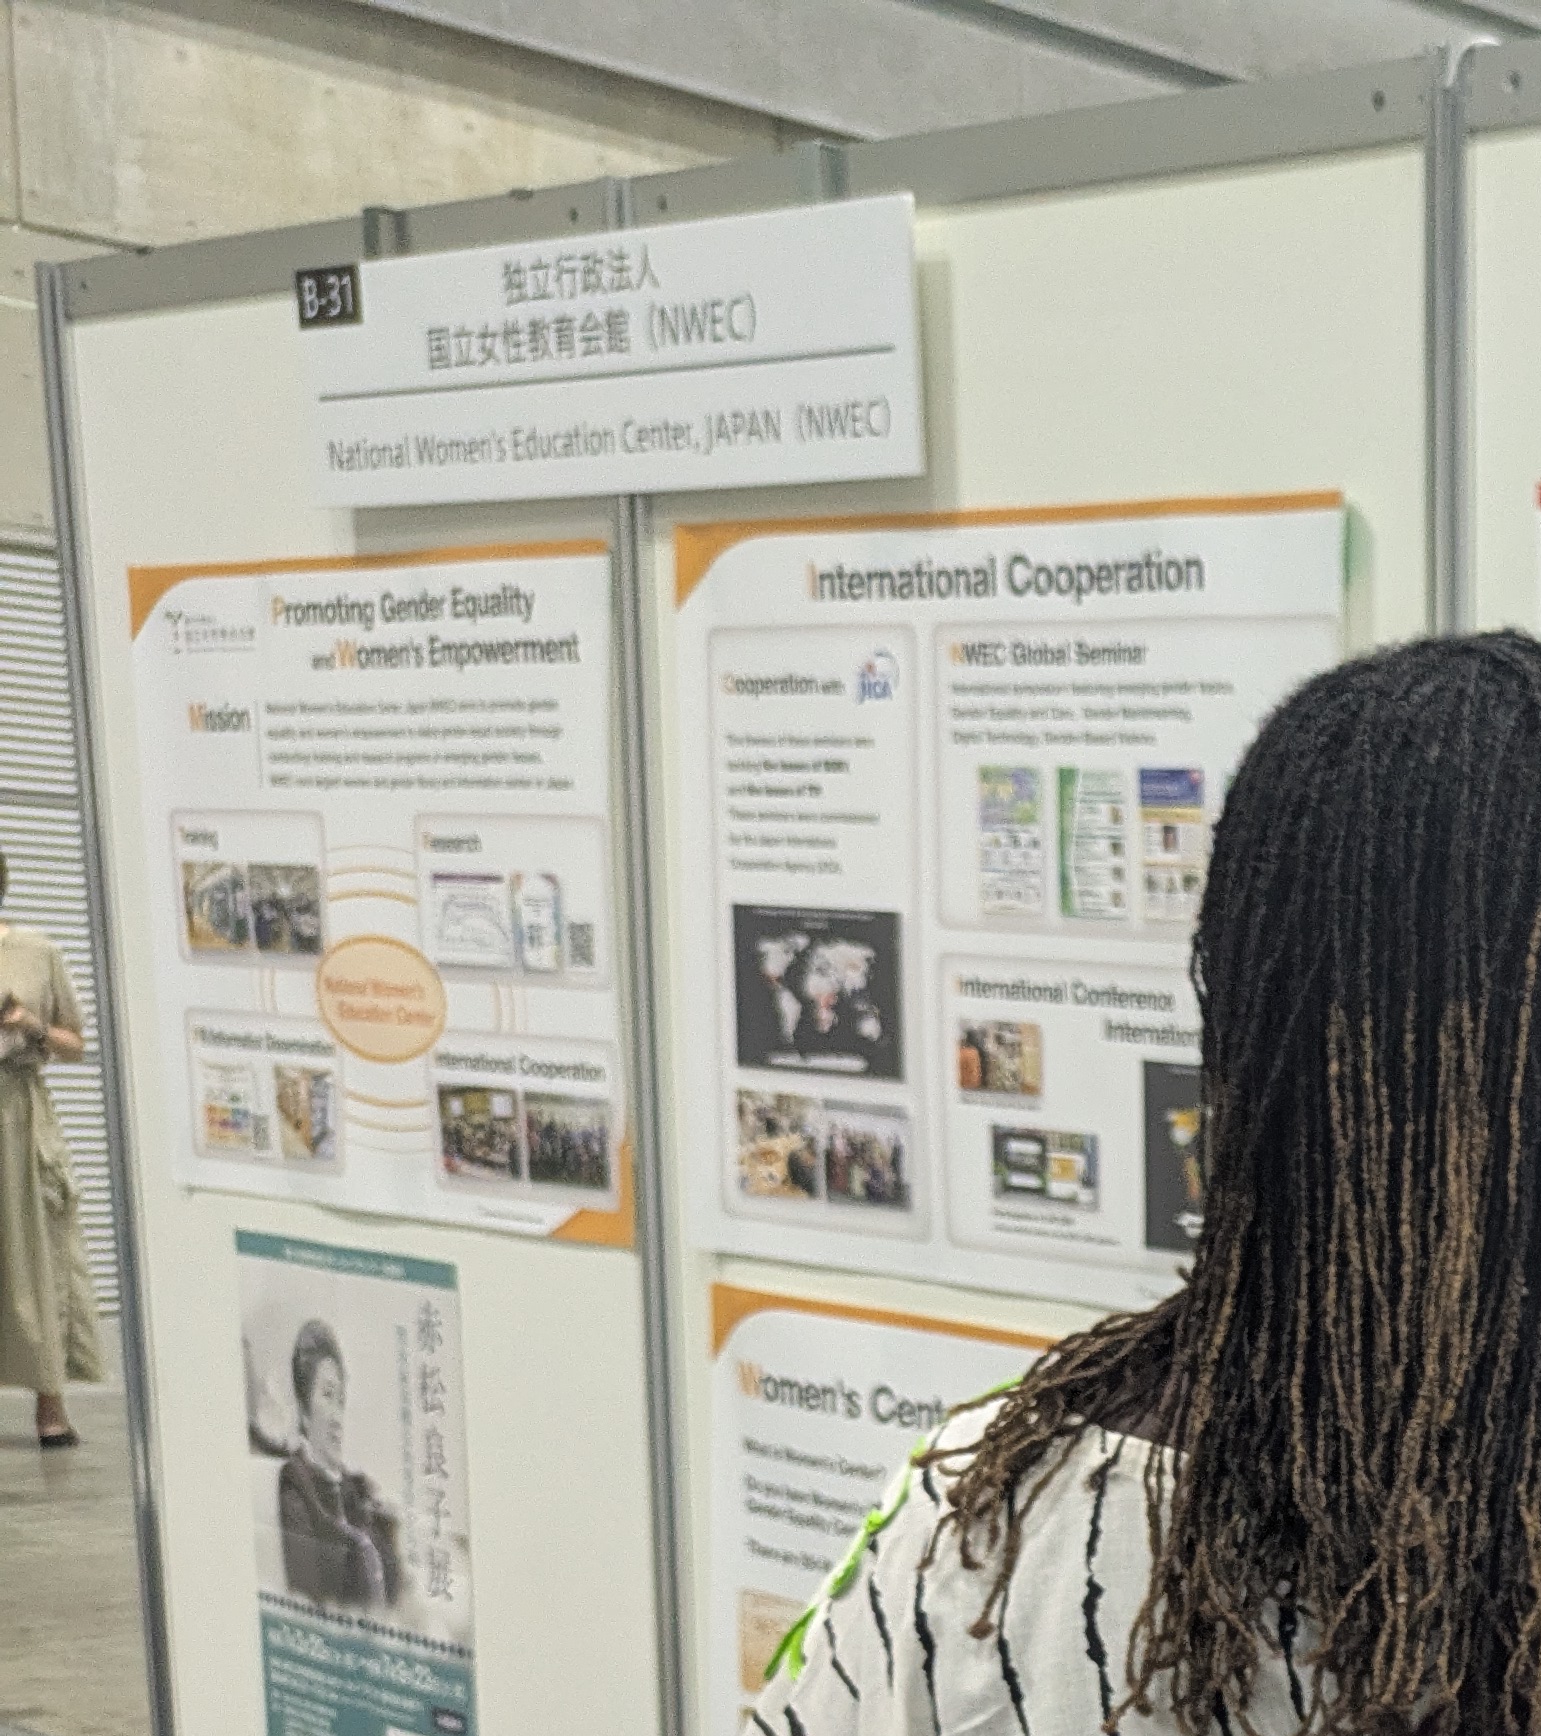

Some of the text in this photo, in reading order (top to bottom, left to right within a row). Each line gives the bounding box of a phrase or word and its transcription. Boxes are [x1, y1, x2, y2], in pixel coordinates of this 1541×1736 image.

[302, 275, 354, 319] B-31
[501, 244, 660, 307] 独立行政法人
[327, 435, 410, 473] National
[413, 430, 508, 468] Women's
[512, 420, 616, 462] Education
[620, 415, 701, 457] Center,
[703, 408, 783, 456] JAPAN
[806, 548, 1207, 605] International Cooperation
[272, 582, 537, 632] Promoting Gender Equality
[334, 638, 424, 671] Women's
[427, 629, 582, 675] Empowerment
[949, 638, 1148, 667] NWEC Global Seminar
[723, 672, 819, 698] Cooperation
[188, 701, 251, 734] Mission
[957, 977, 1068, 1005] International
[1105, 1019, 1200, 1048] Internation
[736, 1361, 948, 1431] Women's Cent
